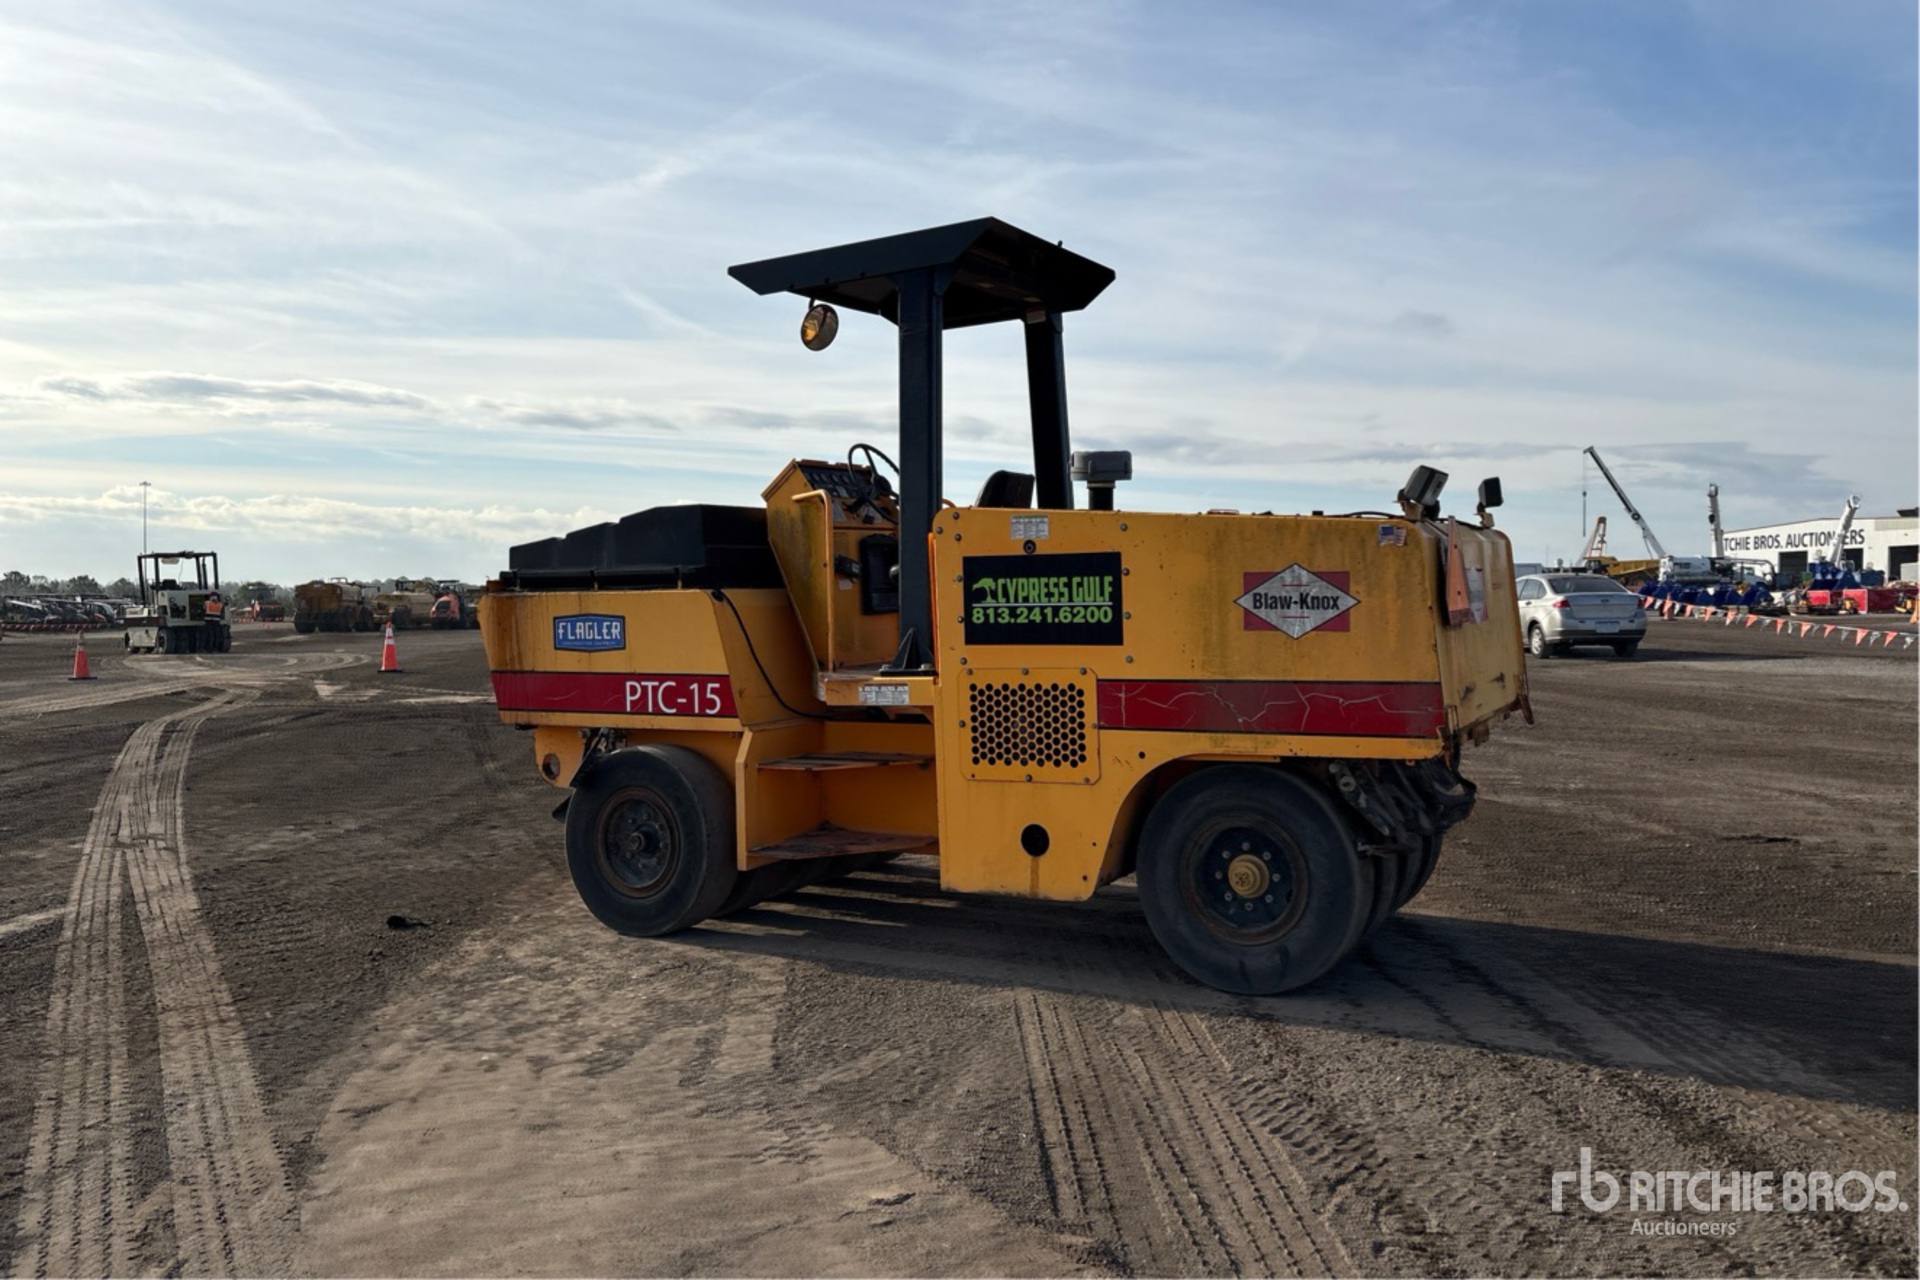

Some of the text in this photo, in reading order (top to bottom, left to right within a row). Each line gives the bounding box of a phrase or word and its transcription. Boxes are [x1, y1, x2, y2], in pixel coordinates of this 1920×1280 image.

[1724, 529, 1865, 551] TCHIE BROS. AUCTIONERS
[997, 576, 1113, 604] CYPRESS GULF
[1253, 592, 1340, 610] Blaw-Knox
[972, 606, 1113, 624] 813.241.6200
[558, 621, 621, 640] FLAGLER
[625, 681, 721, 715] PTC-15
